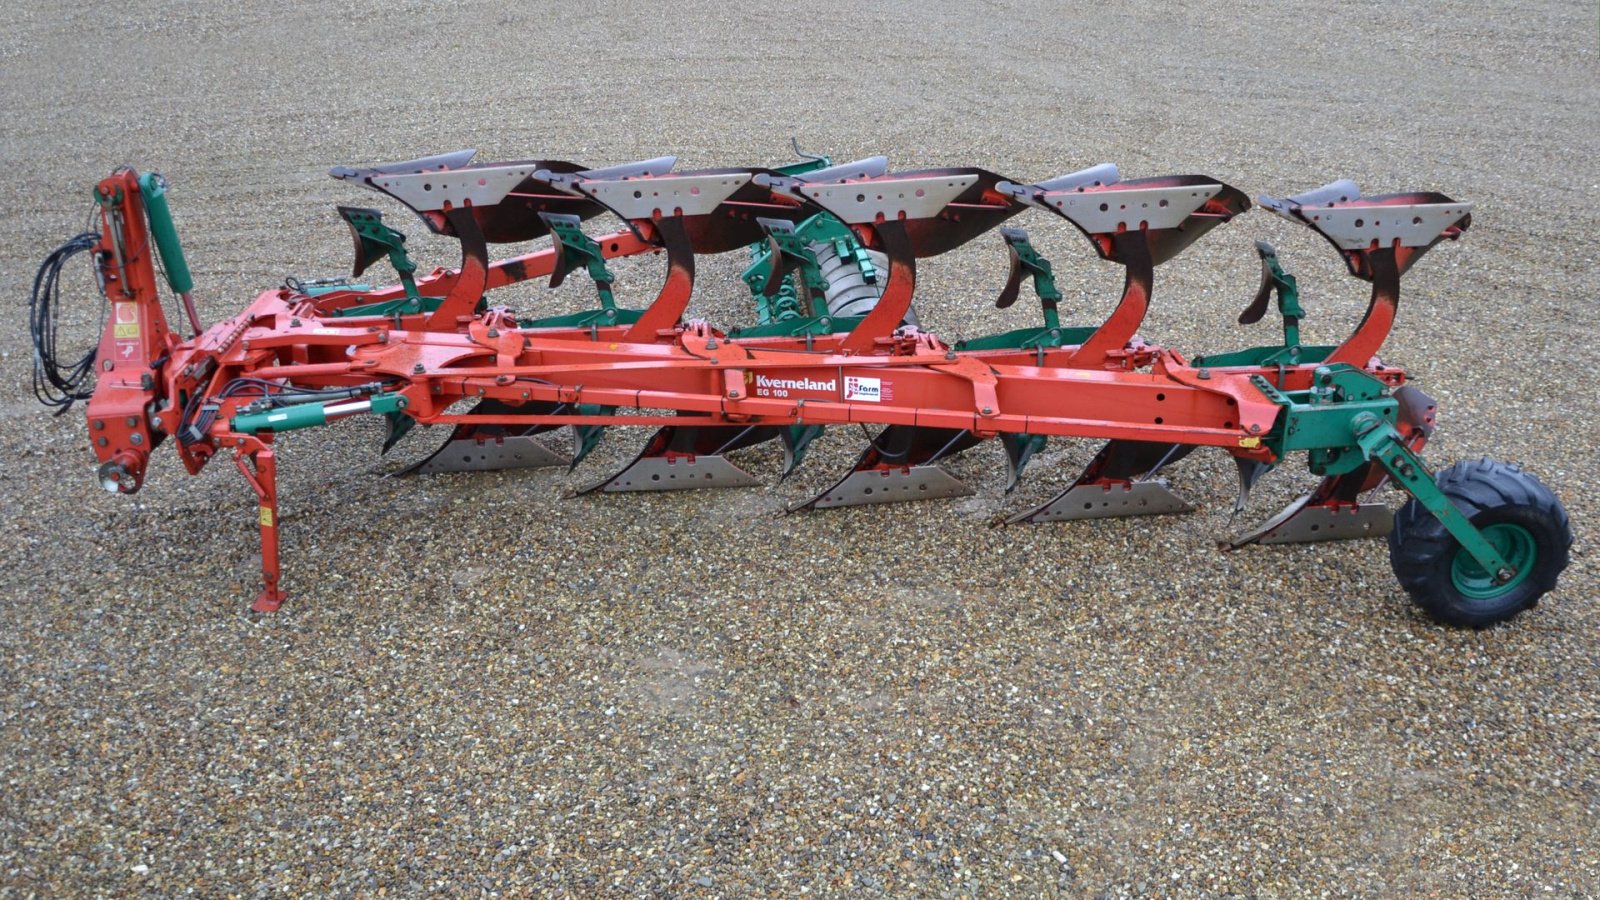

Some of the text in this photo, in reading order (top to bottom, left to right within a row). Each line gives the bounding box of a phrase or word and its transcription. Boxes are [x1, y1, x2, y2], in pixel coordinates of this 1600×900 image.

[756, 375, 836, 391] Kverneland
[757, 388, 788, 397] EG 100
